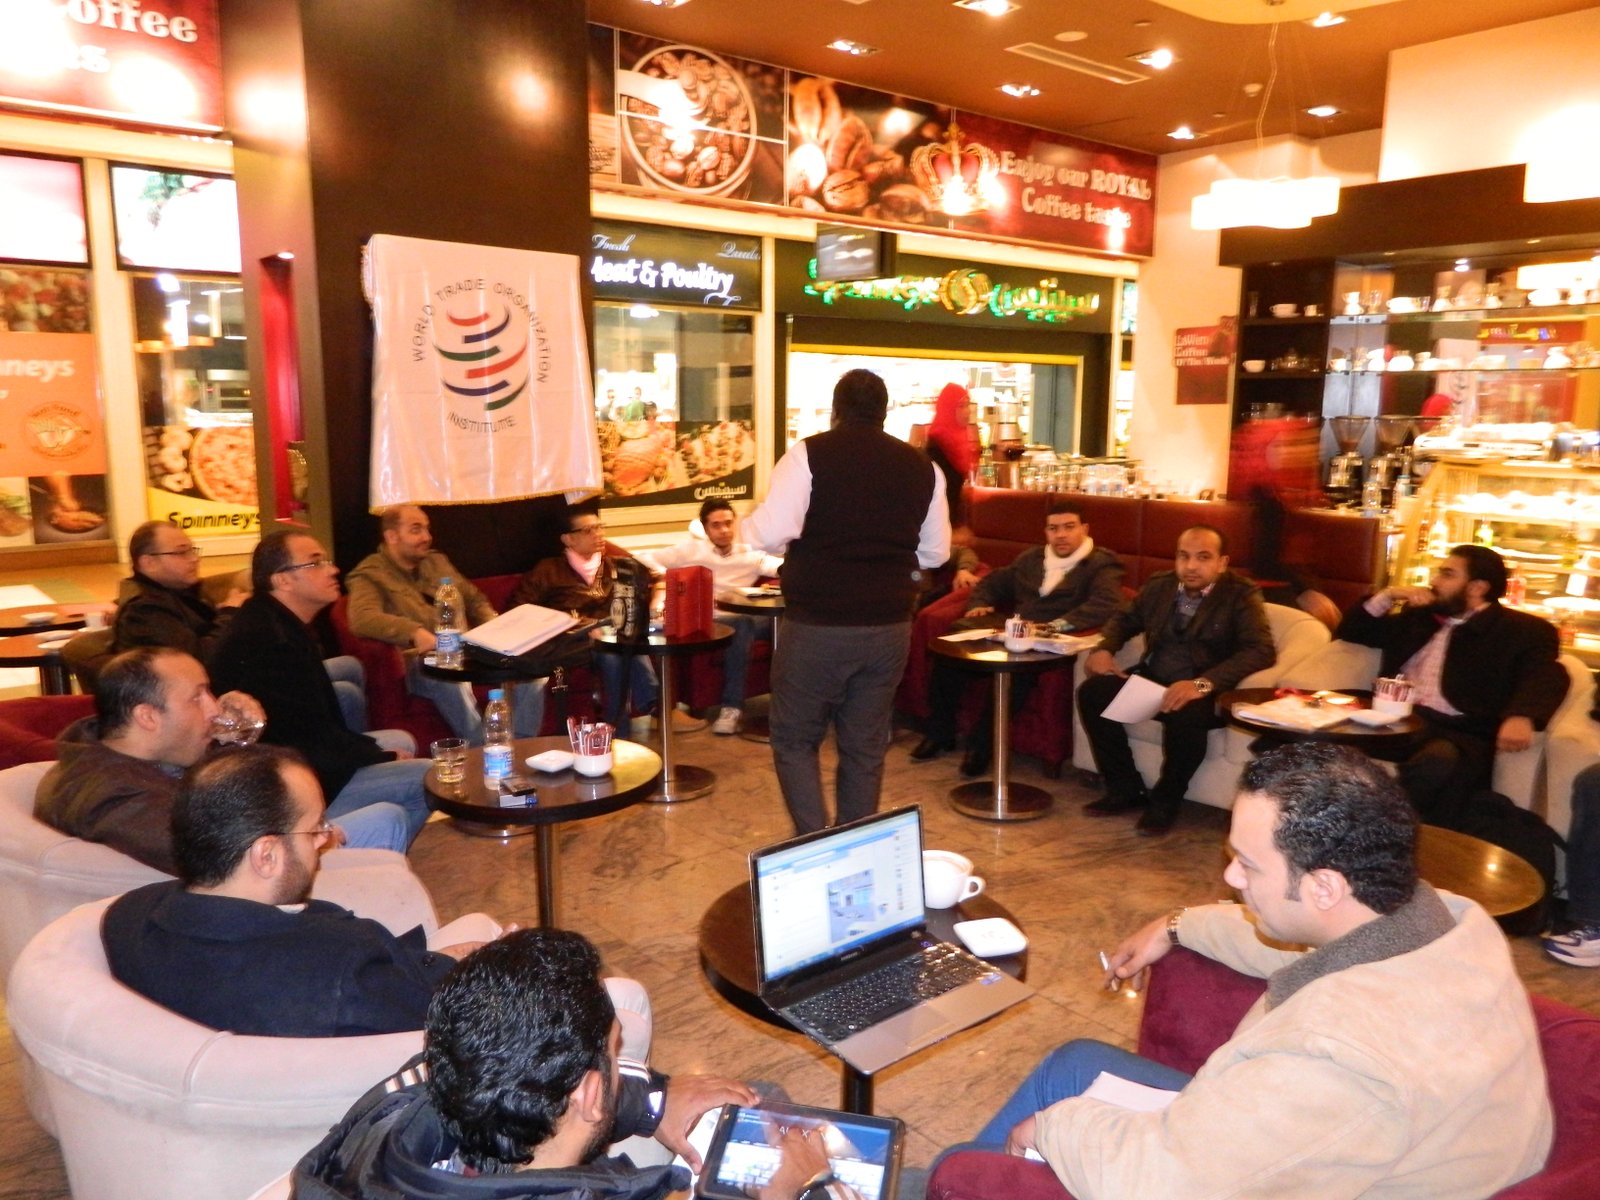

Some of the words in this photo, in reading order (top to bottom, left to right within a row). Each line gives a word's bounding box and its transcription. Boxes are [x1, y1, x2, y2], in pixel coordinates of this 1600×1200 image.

[48, 0, 198, 43] offee
[1000, 150, 1056, 186] Enjoy
[1057, 167, 1089, 188] our
[1090, 169, 1152, 200] ROYAL
[1021, 187, 1081, 220] Coffee
[1084, 202, 1132, 229] taste
[639, 259, 659, 288] &
[660, 262, 741, 306] Poultry
[412, 304, 435, 362] WORLD
[434, 278, 486, 301] TRADE
[493, 282, 551, 383] ORGANIZATION
[446, 411, 517, 433] INSTITUTE
